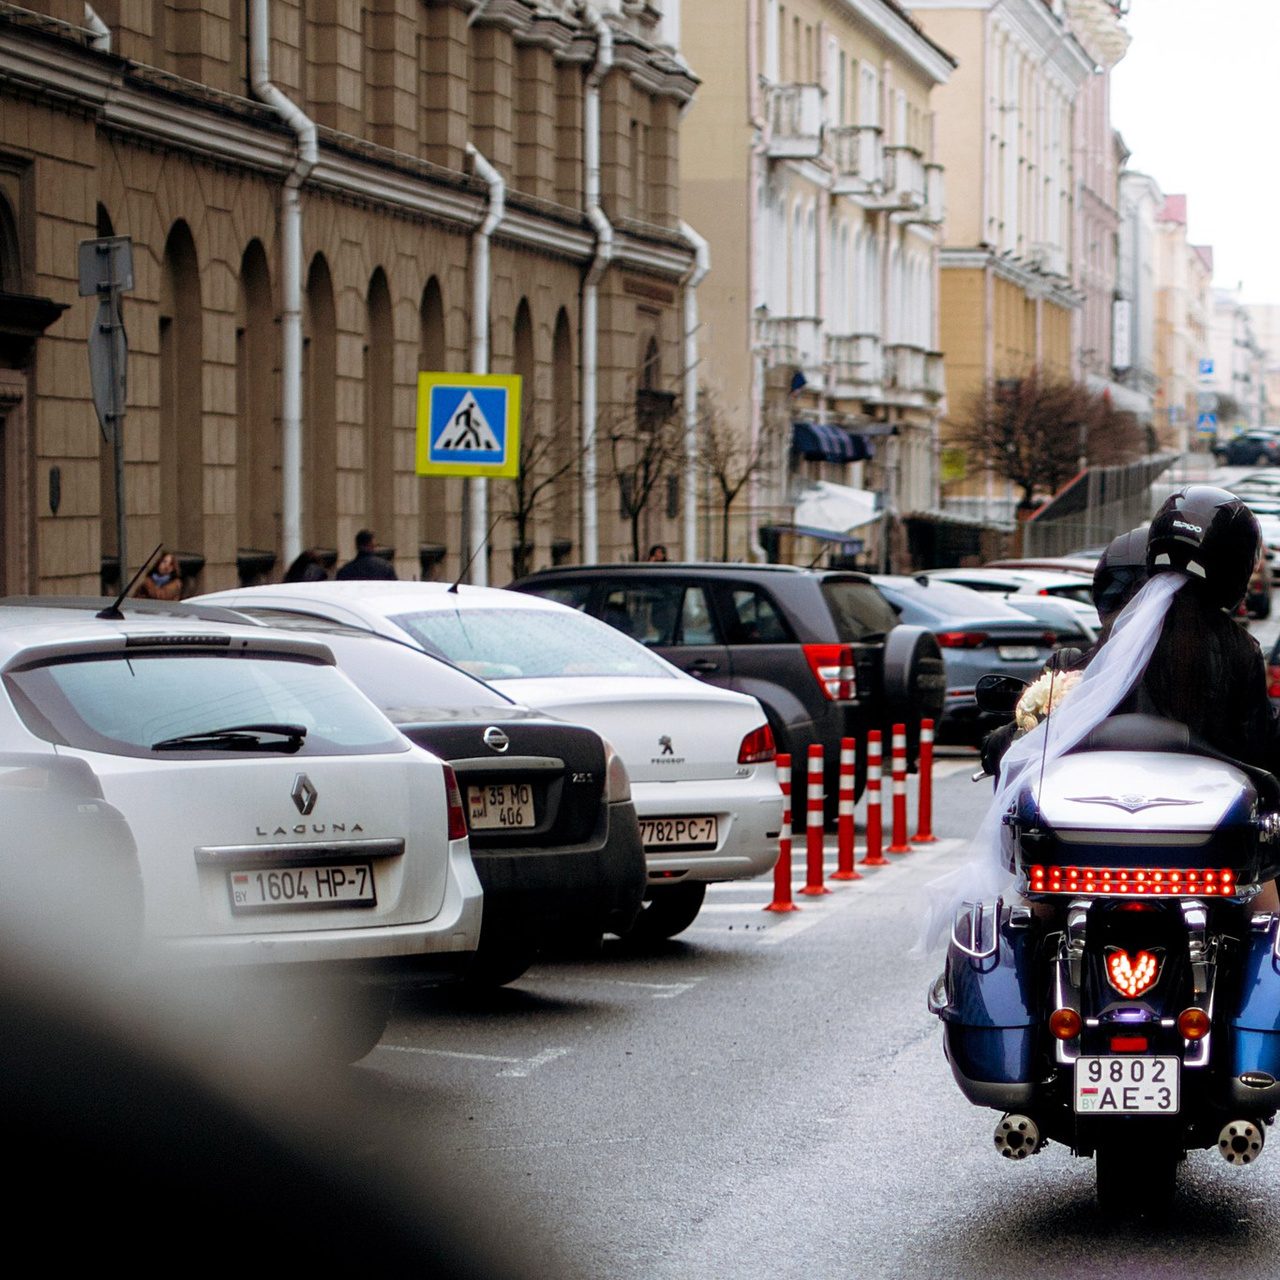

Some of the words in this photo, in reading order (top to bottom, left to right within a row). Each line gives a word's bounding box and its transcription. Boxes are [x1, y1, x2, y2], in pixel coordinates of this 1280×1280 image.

[489, 787, 505, 805] 35
[499, 807, 523, 825] 406
[256, 823, 364, 836] LAGUNA
[256, 871, 309, 901] 1604
[315, 867, 367, 897] HP-7
[235, 891, 247, 902] BY
[1088, 1060, 1165, 1082] 9802
[1082, 1099, 1097, 1109] BY
[1099, 1087, 1171, 1109] AE-3
